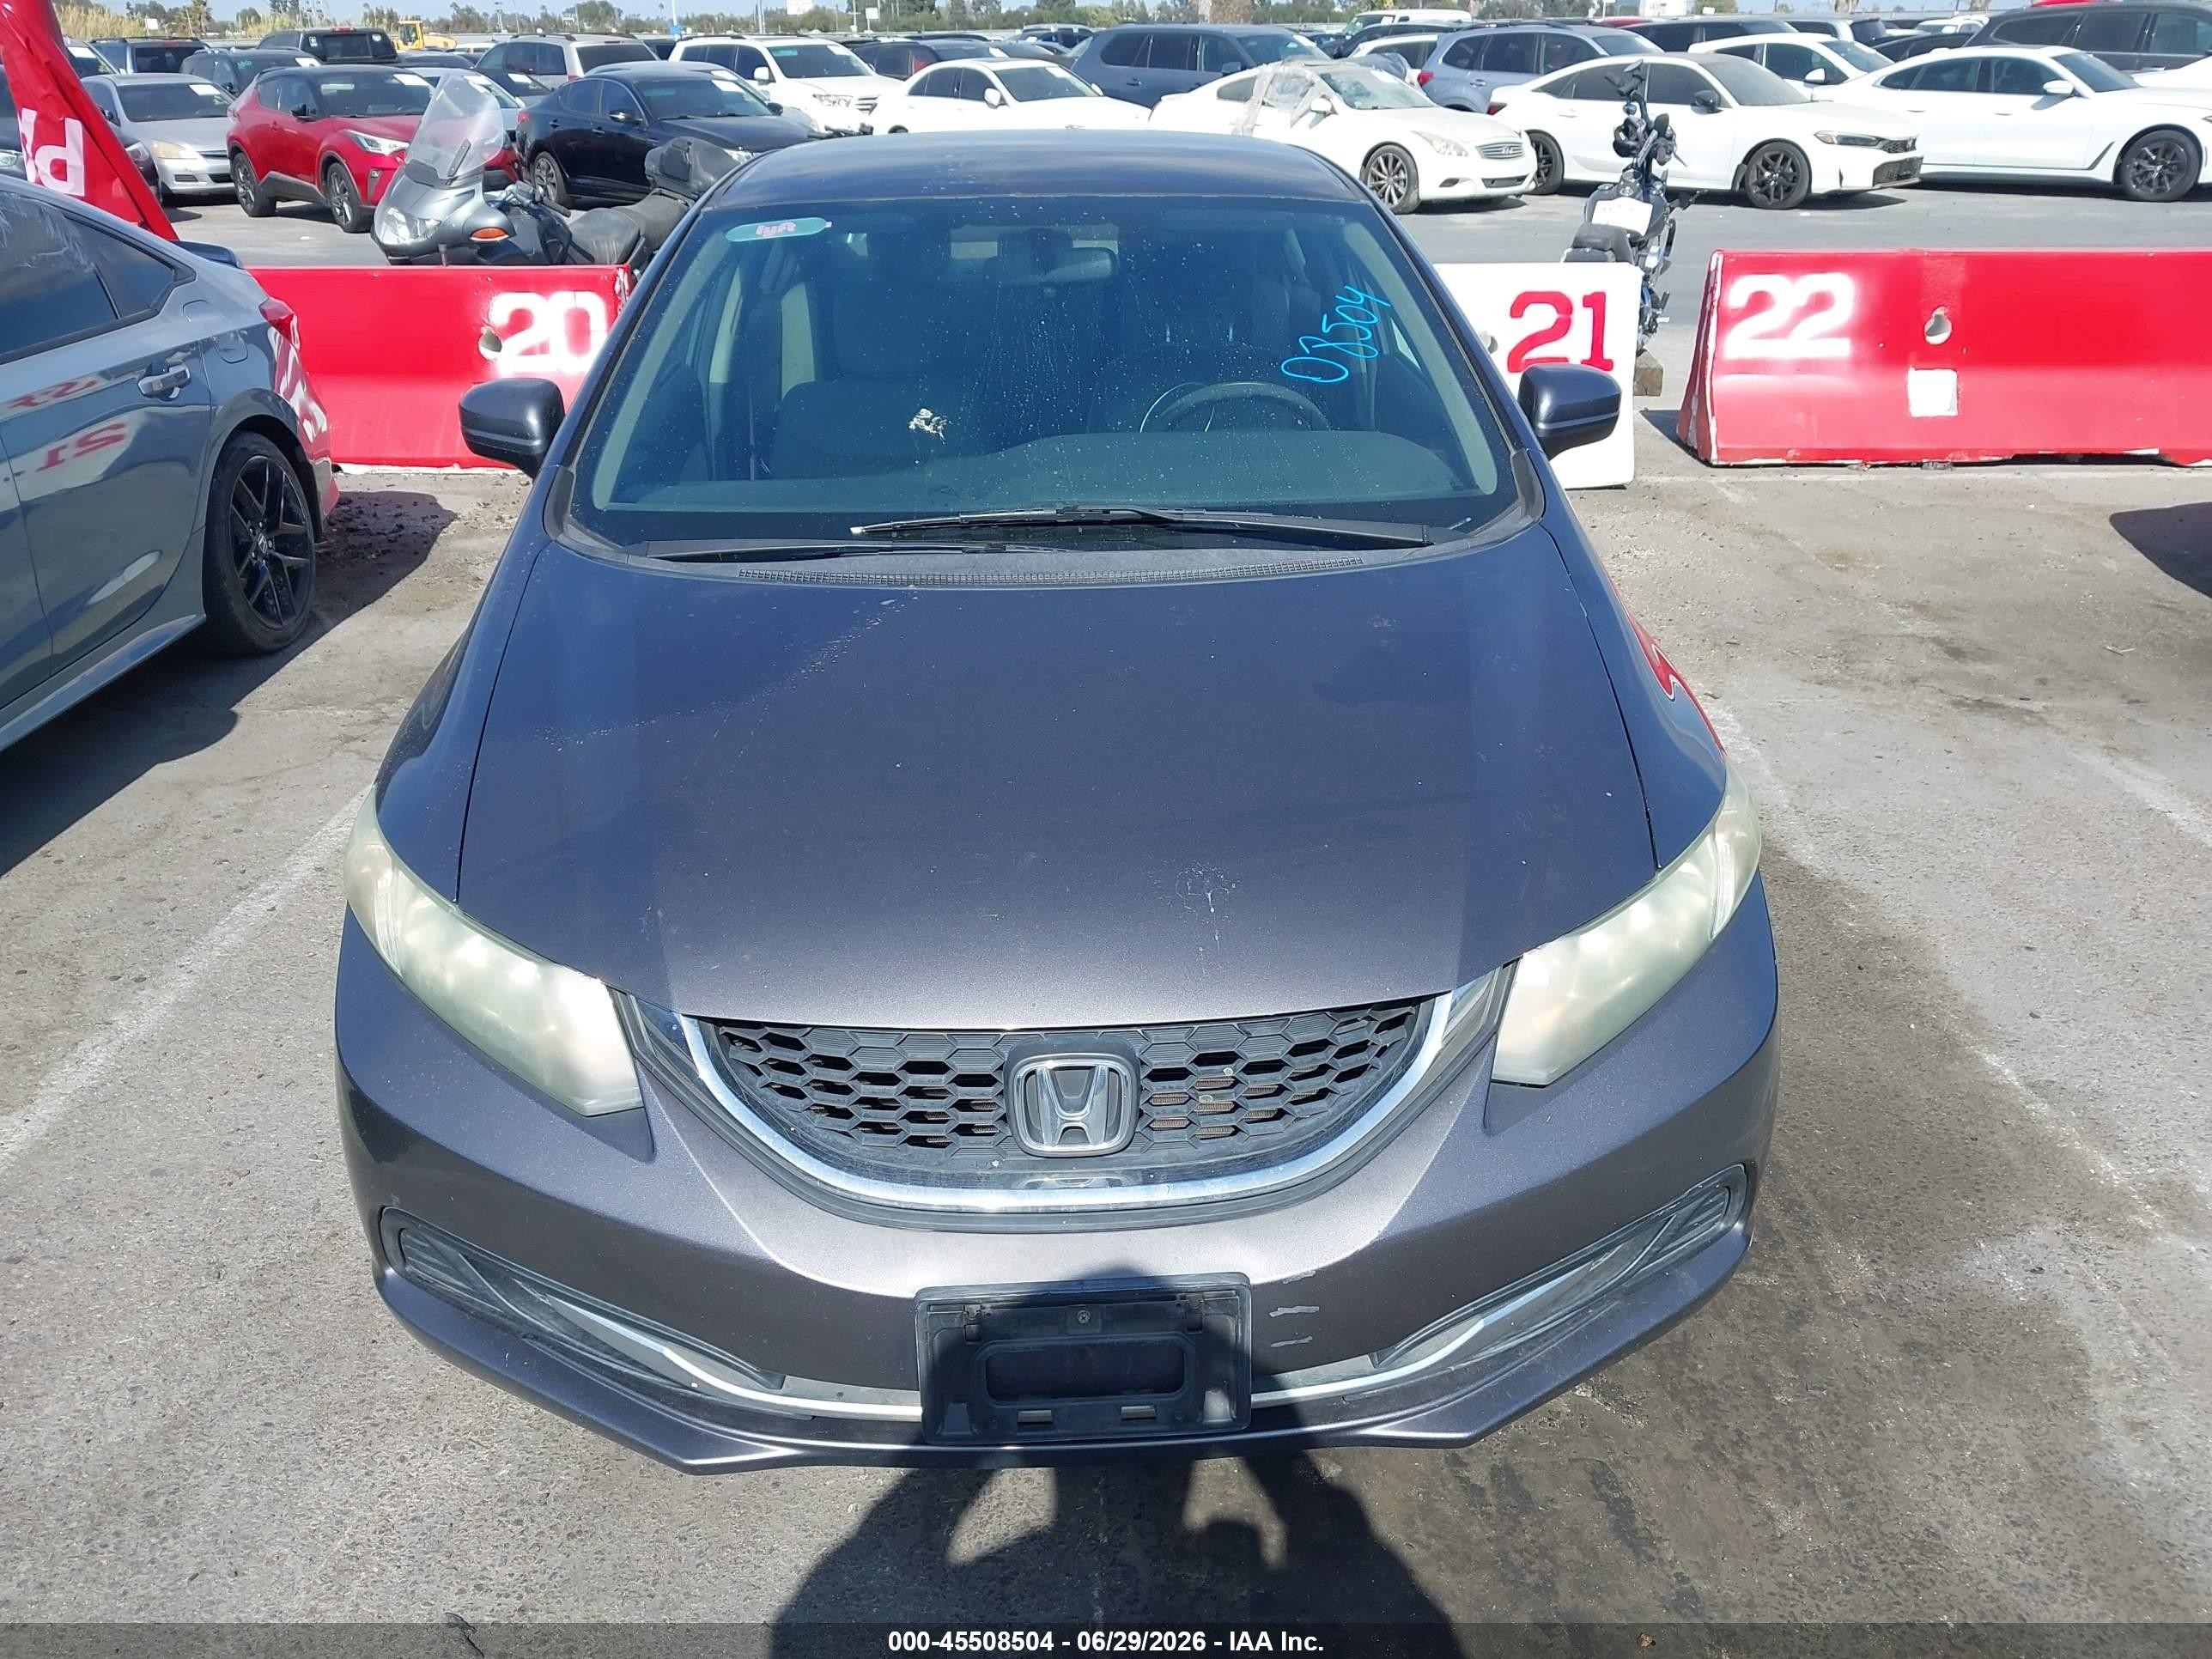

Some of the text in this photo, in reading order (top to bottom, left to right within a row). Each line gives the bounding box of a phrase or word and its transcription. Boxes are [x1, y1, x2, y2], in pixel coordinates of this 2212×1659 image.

[756, 221, 797, 238] lyft
[488, 290, 609, 376] 20
[1507, 289, 1615, 374] 21
[1723, 271, 1856, 362] 22
